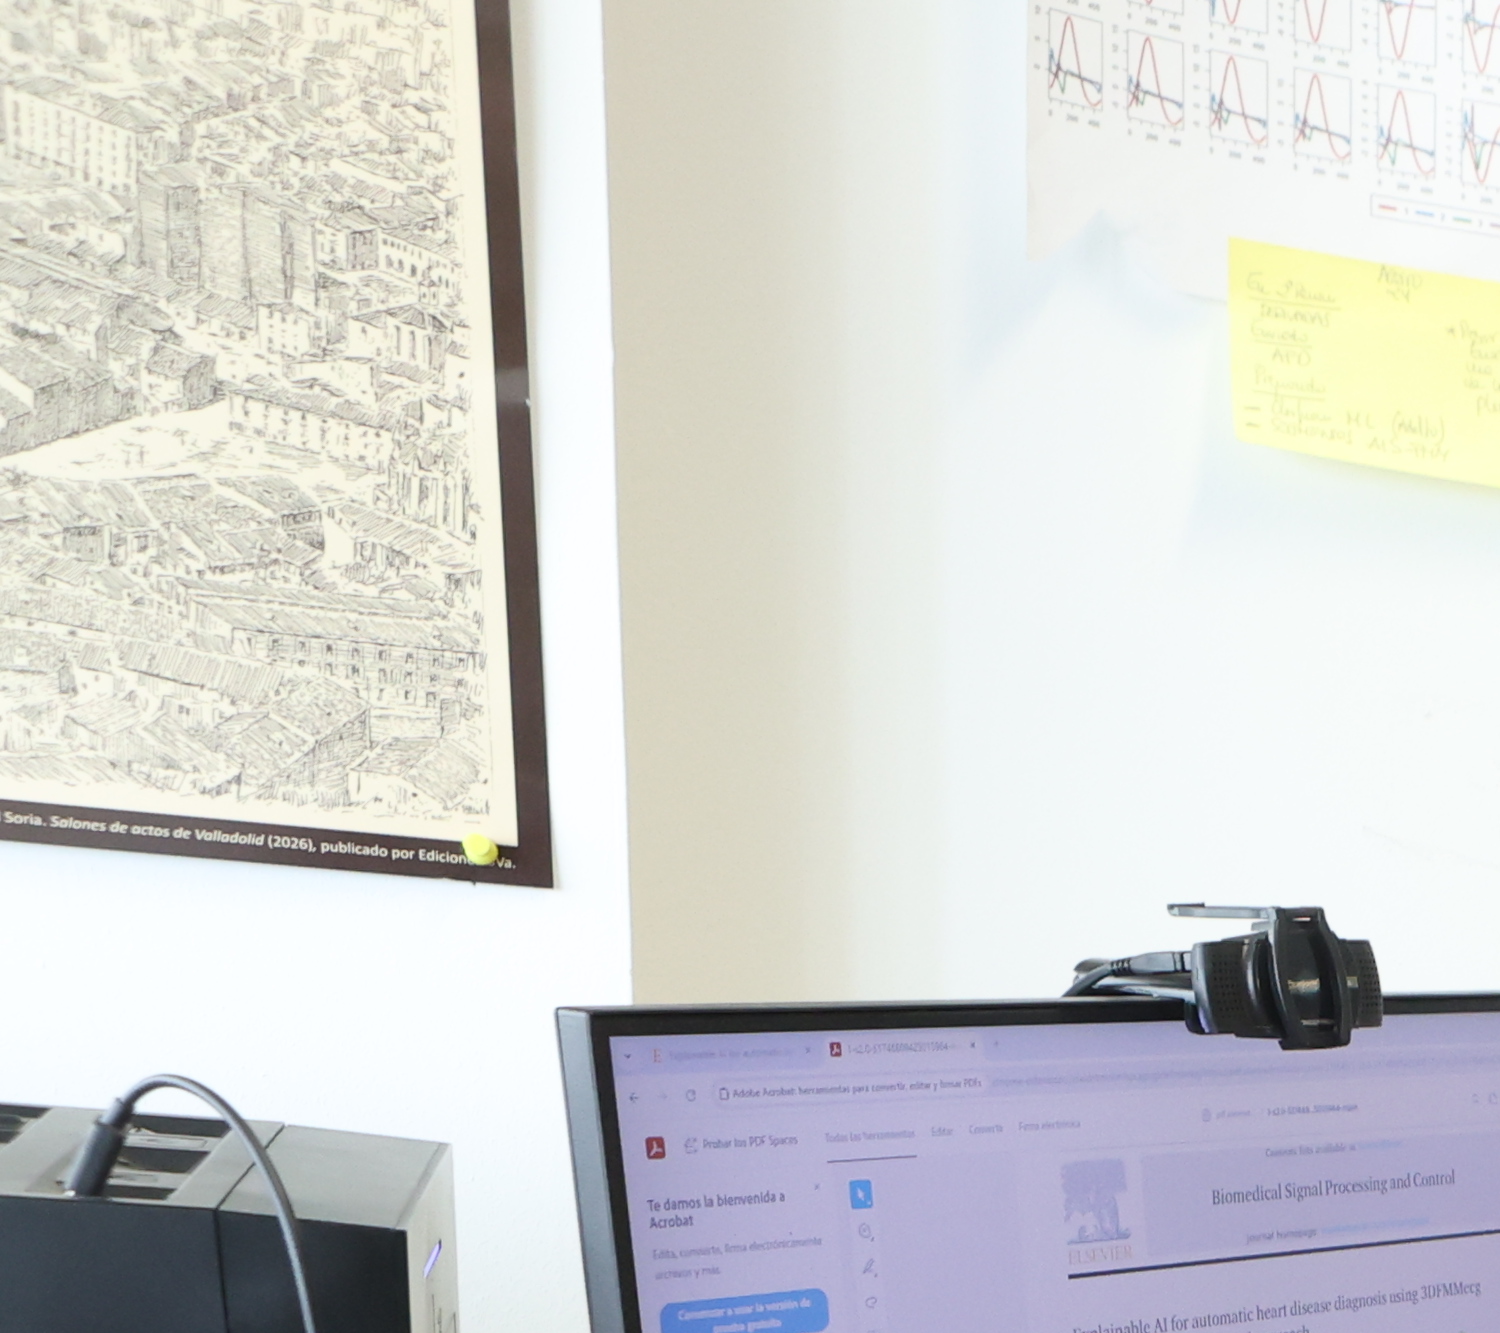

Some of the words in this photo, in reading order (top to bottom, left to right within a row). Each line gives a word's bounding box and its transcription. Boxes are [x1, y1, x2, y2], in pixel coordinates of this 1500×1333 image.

[4, 811, 48, 828] Soria.
[50, 815, 106, 832] Salones
[109, 821, 128, 834] de
[130, 825, 170, 839] actos
[172, 827, 192, 840] de
[194, 829, 265, 847] Valladolid
[267, 834, 318, 855] (2026),
[321, 840, 388, 859] publicado
[391, 850, 416, 863] por
[647, 1198, 661, 1212] Te
[664, 1196, 700, 1211] damos
[704, 1195, 714, 1208] la
[716, 1192, 776, 1208] bienvenida
[777, 1192, 786, 1203] a
[1212, 1183, 1282, 1206] Biomedical
[1285, 1180, 1323, 1203] Signal
[1326, 1176, 1388, 1197] Processing
[1390, 1173, 1411, 1190] and
[1413, 1169, 1456, 1187] Control
[650, 1216, 693, 1230] Acrobat
[1171, 1313, 1189, 1333] for
[1192, 1305, 1254, 1331] automatic
[1257, 1299, 1288, 1322] heart
[1290, 1296, 1332, 1317] disease
[1334, 1290, 1388, 1313] diagnosis
[1390, 1286, 1419, 1306] using
[1421, 1281, 1482, 1301] 3DFMMecg
